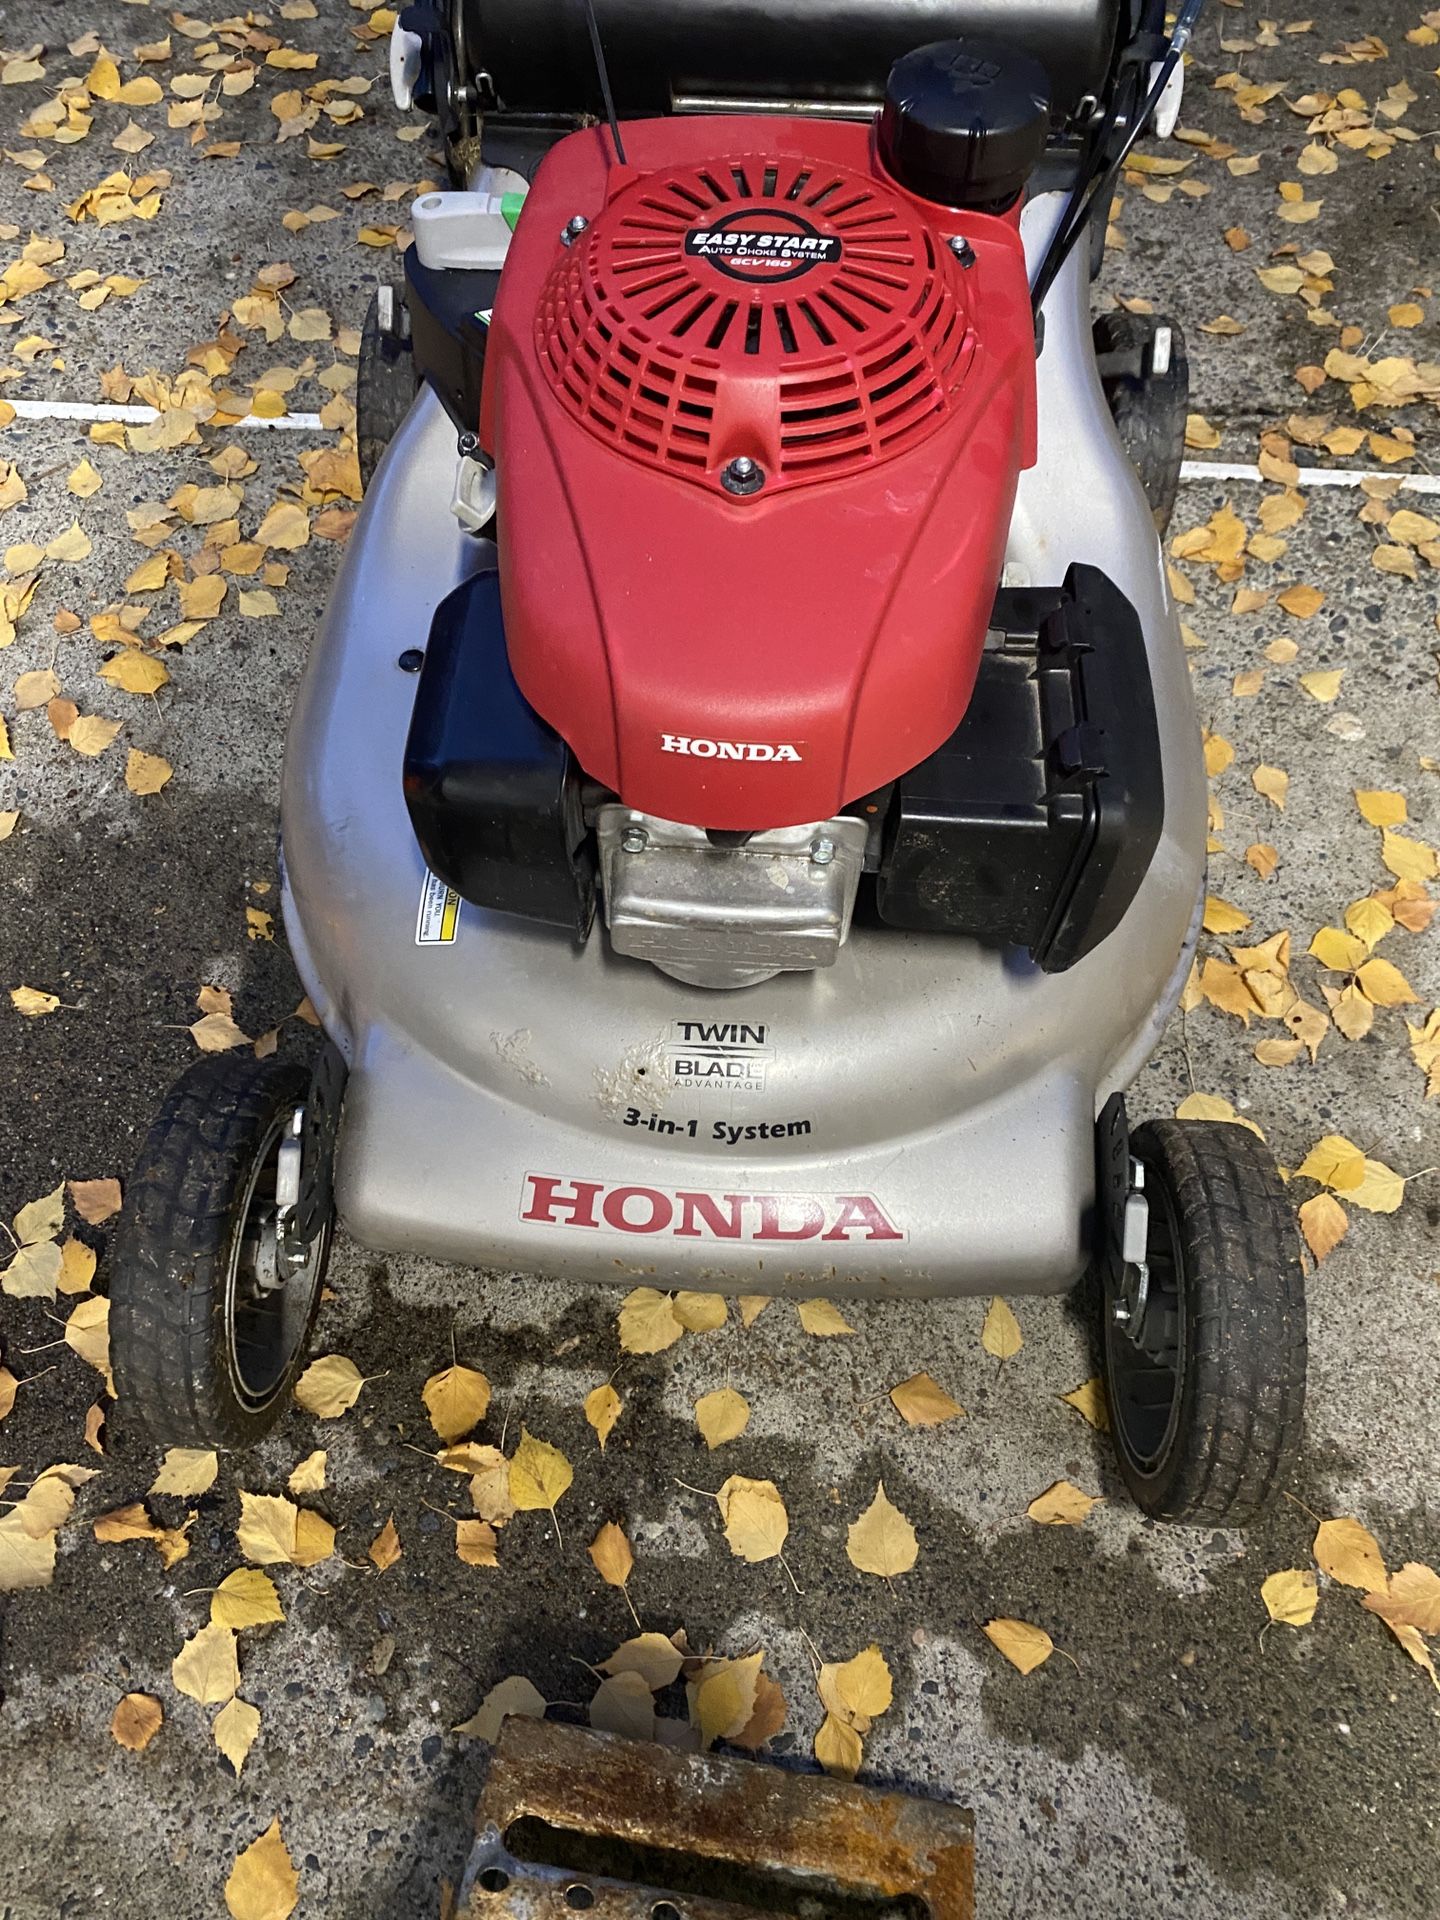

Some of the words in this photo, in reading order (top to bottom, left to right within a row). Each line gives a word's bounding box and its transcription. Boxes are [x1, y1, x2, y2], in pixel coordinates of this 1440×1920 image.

[692, 233, 756, 246] EASY
[757, 235, 834, 251] START
[698, 245, 733, 255] AUTO
[736, 246, 777, 256] CHOKE
[781, 250, 827, 260] SYSTEM
[730, 257, 792, 268] GCV160
[661, 734, 802, 762] HONDA
[677, 1022, 765, 1044] TWIN
[674, 1078, 763, 1091] ADVANTAGE
[623, 1107, 698, 1138] 3-in-1
[712, 1120, 811, 1145] System
[522, 1175, 904, 1241] HONDA
